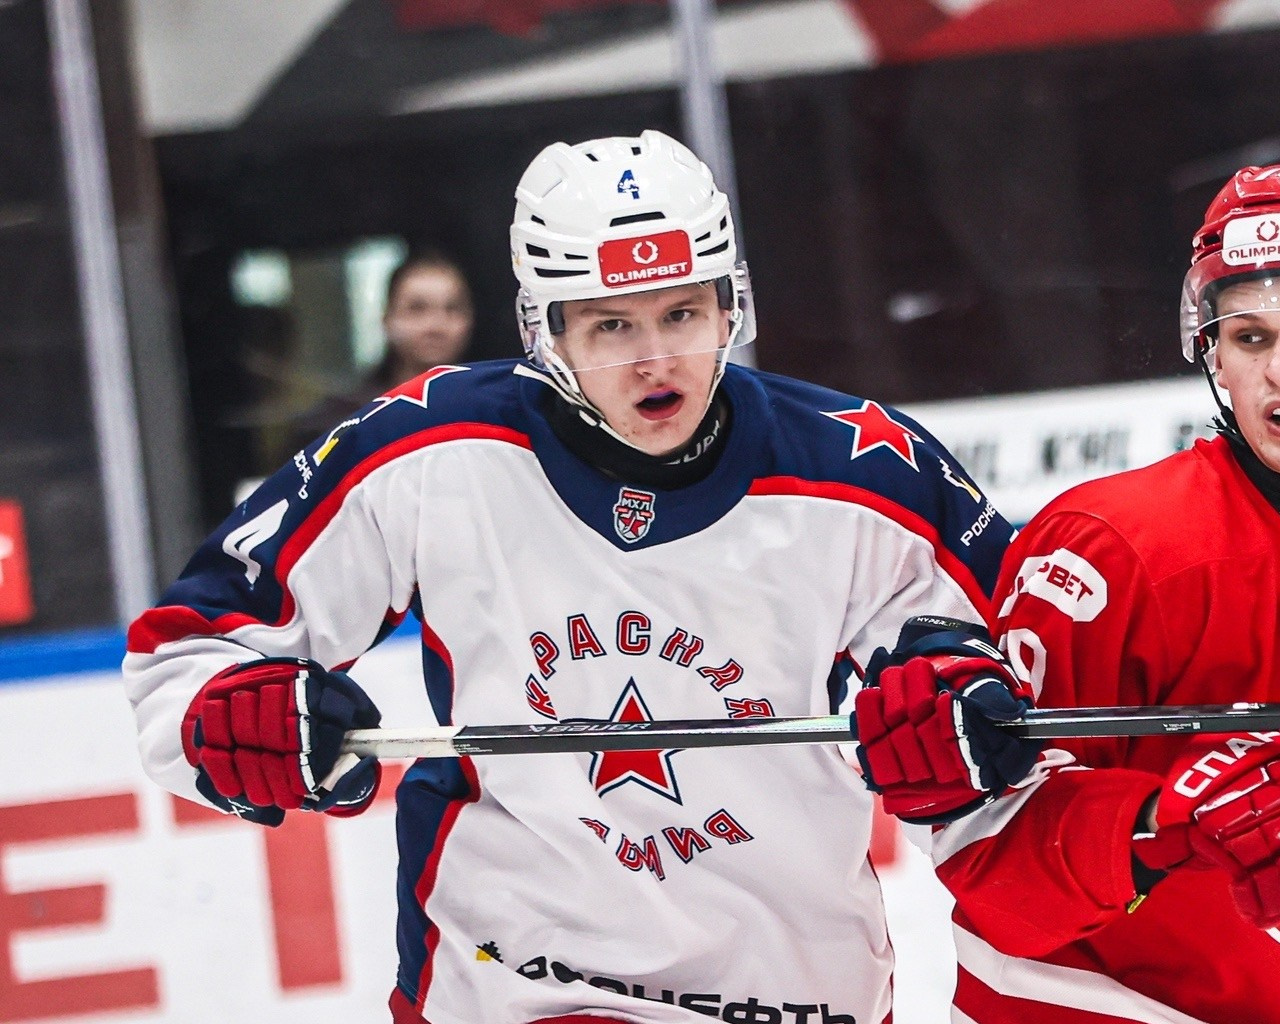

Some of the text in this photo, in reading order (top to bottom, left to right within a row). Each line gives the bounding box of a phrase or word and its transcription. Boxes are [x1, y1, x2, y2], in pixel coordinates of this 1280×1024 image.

[617, 169, 640, 199] 4
[606, 261, 688, 284] OLIMPBET
[621, 497, 651, 511] МХЛ
